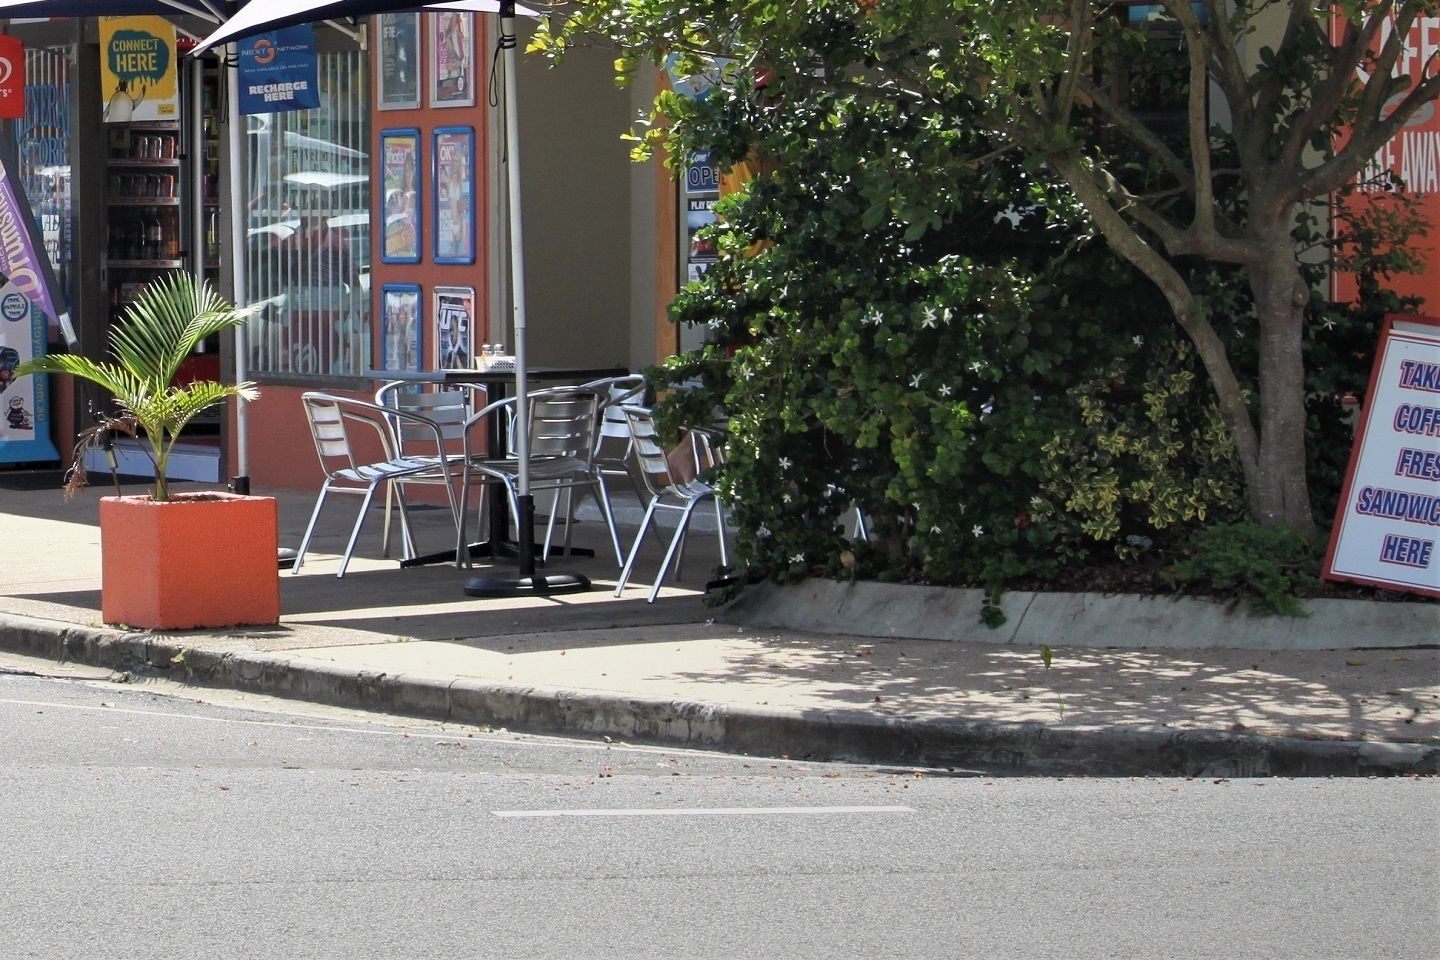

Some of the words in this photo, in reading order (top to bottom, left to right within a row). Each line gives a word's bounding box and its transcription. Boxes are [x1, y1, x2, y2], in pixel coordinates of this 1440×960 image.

[112, 38, 160, 52] CONNECT
[241, 48, 266, 56] NEXT
[116, 53, 158, 72] HERE
[248, 81, 308, 95] RECHARGE
[263, 91, 295, 102] HERE
[688, 166, 720, 186] OPE
[1379, 533, 1435, 569] HERE
